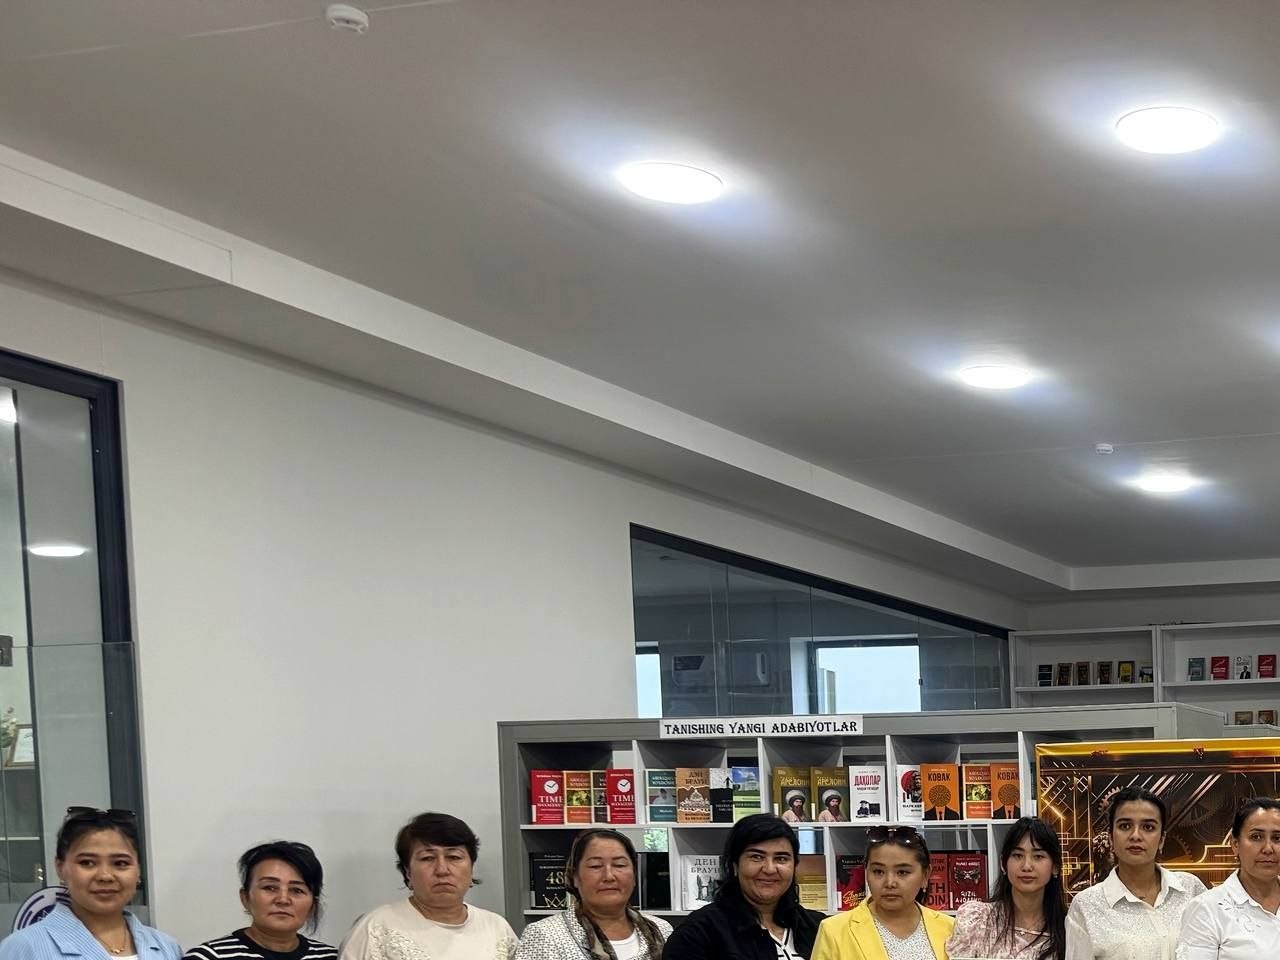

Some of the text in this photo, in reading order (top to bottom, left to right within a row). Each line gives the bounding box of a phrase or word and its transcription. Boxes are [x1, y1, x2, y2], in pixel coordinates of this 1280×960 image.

[664, 720, 857, 735] TANISHING YANGI ADABIYOTLAR
